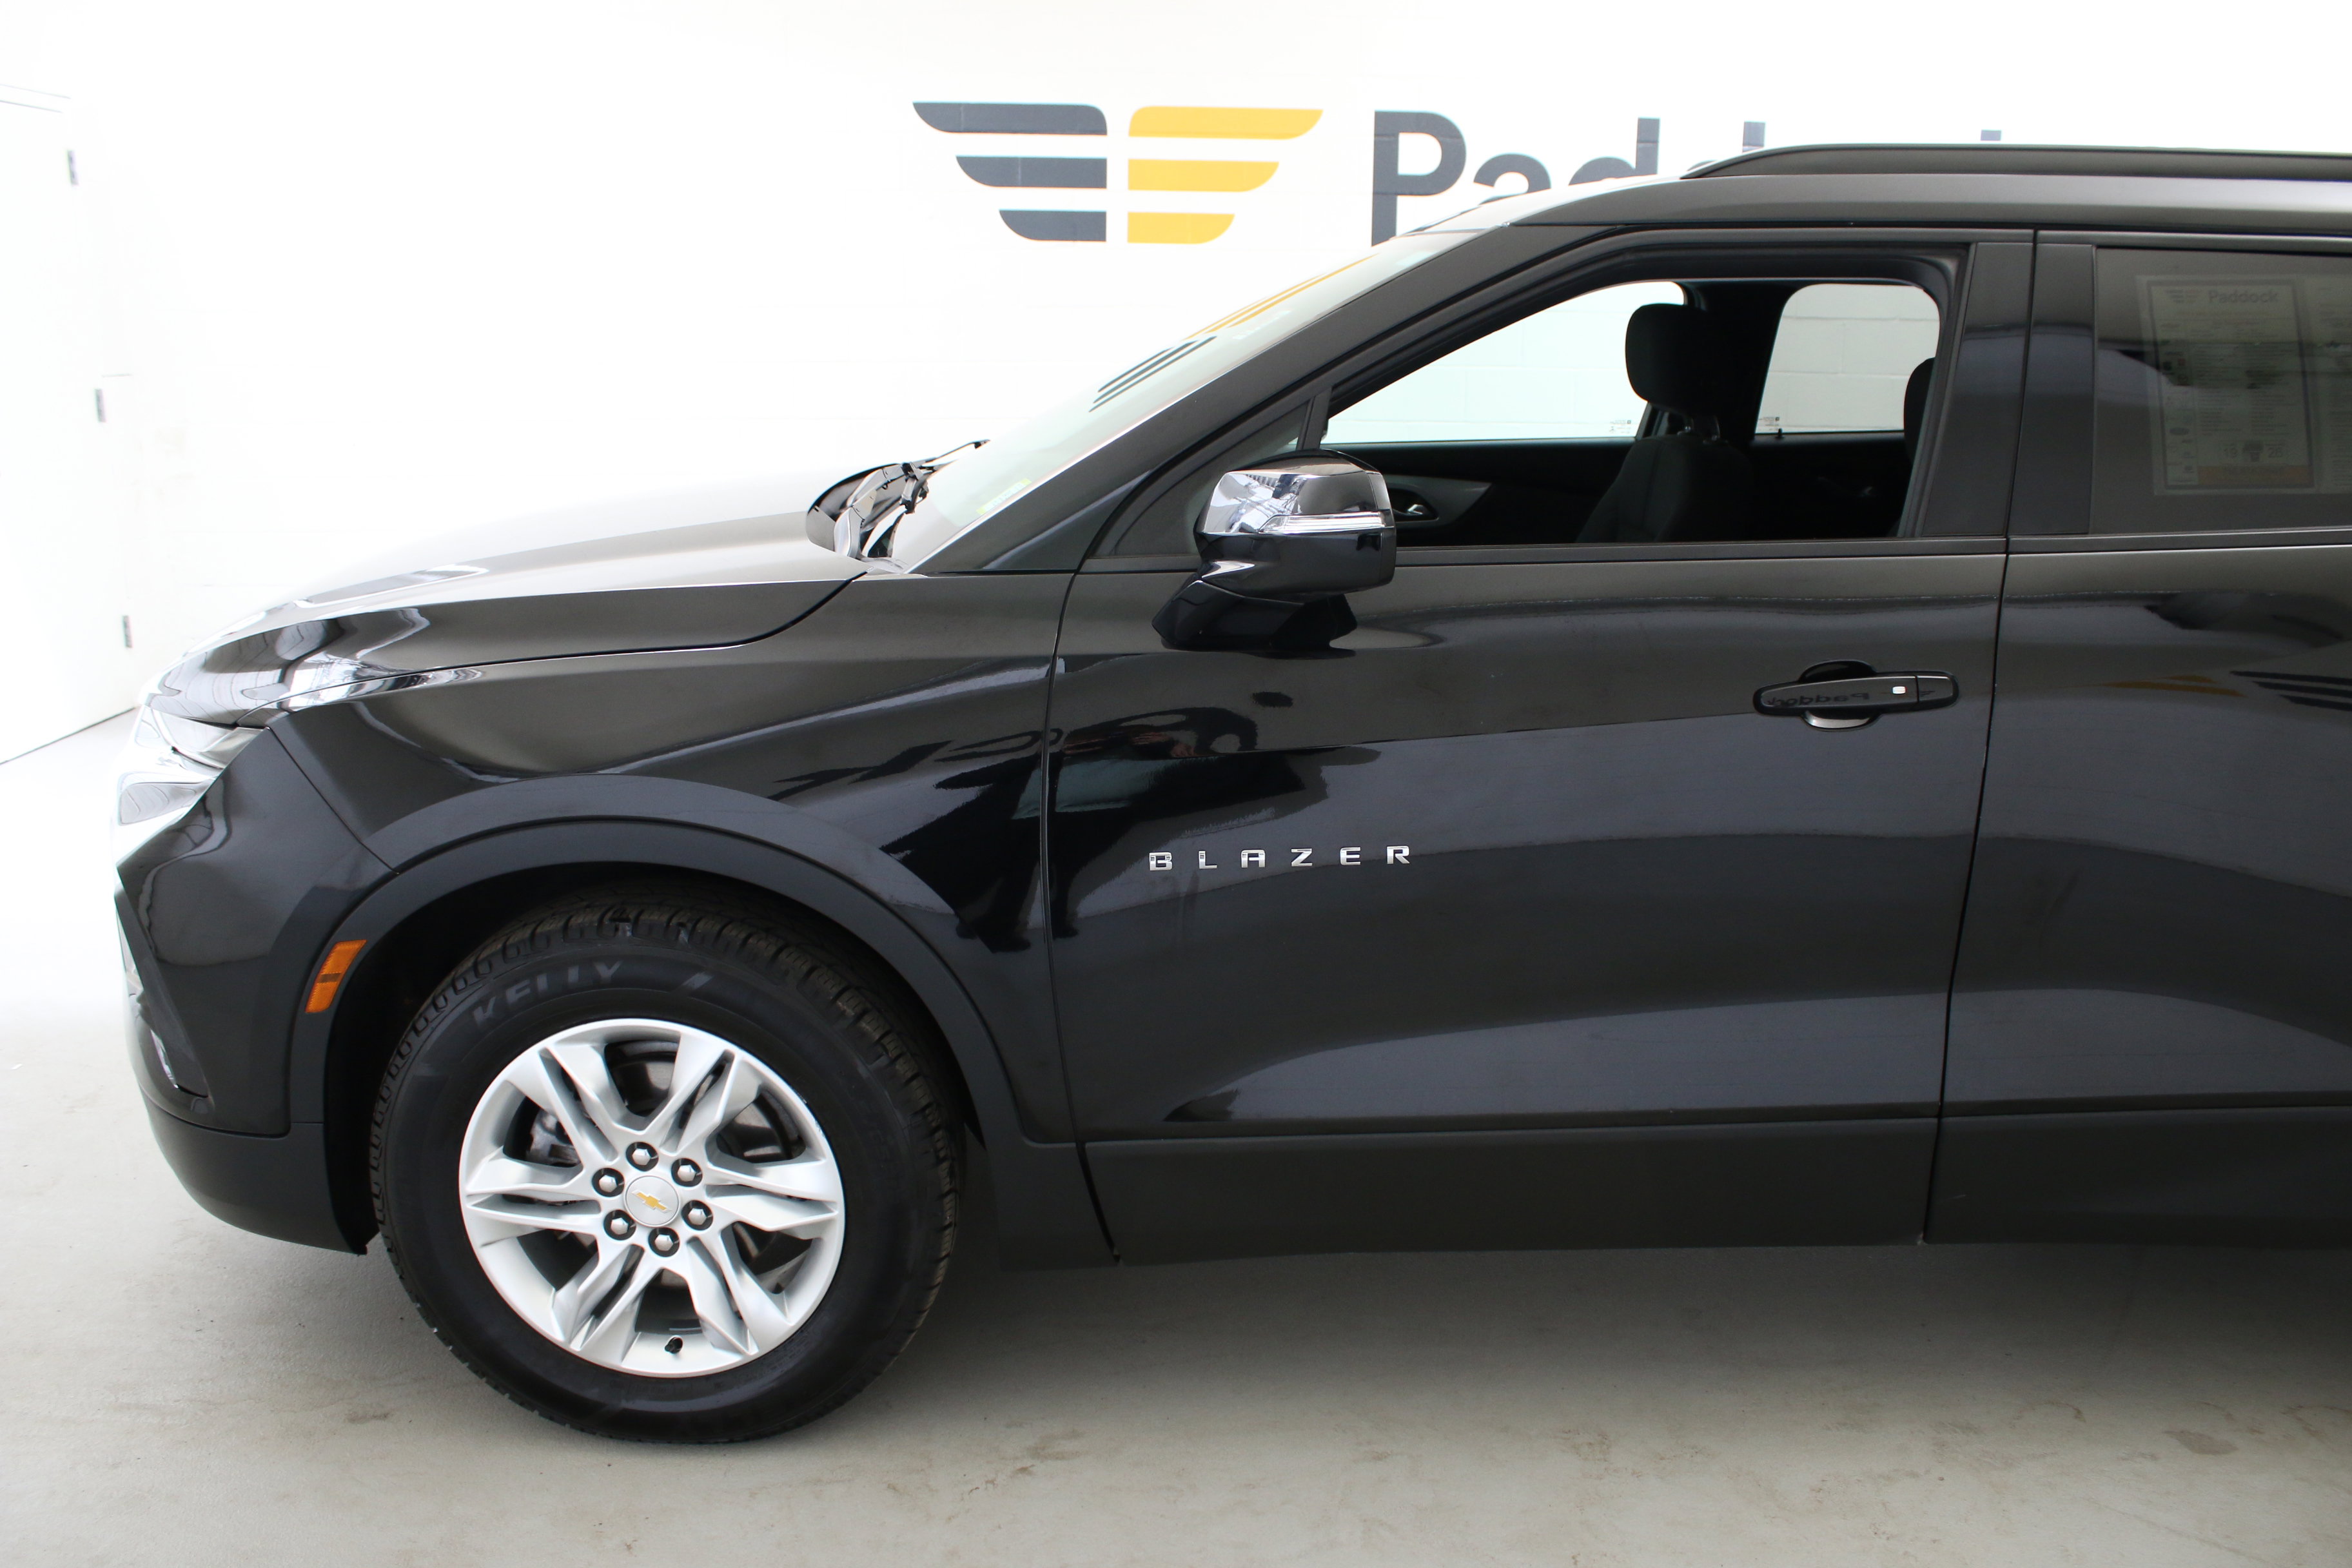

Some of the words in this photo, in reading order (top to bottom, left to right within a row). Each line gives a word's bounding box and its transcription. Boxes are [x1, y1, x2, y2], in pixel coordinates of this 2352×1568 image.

[2208, 289, 2278, 304] Paddock
[1148, 845, 1410, 872] BLAZER
[471, 959, 625, 1027] KELLY
